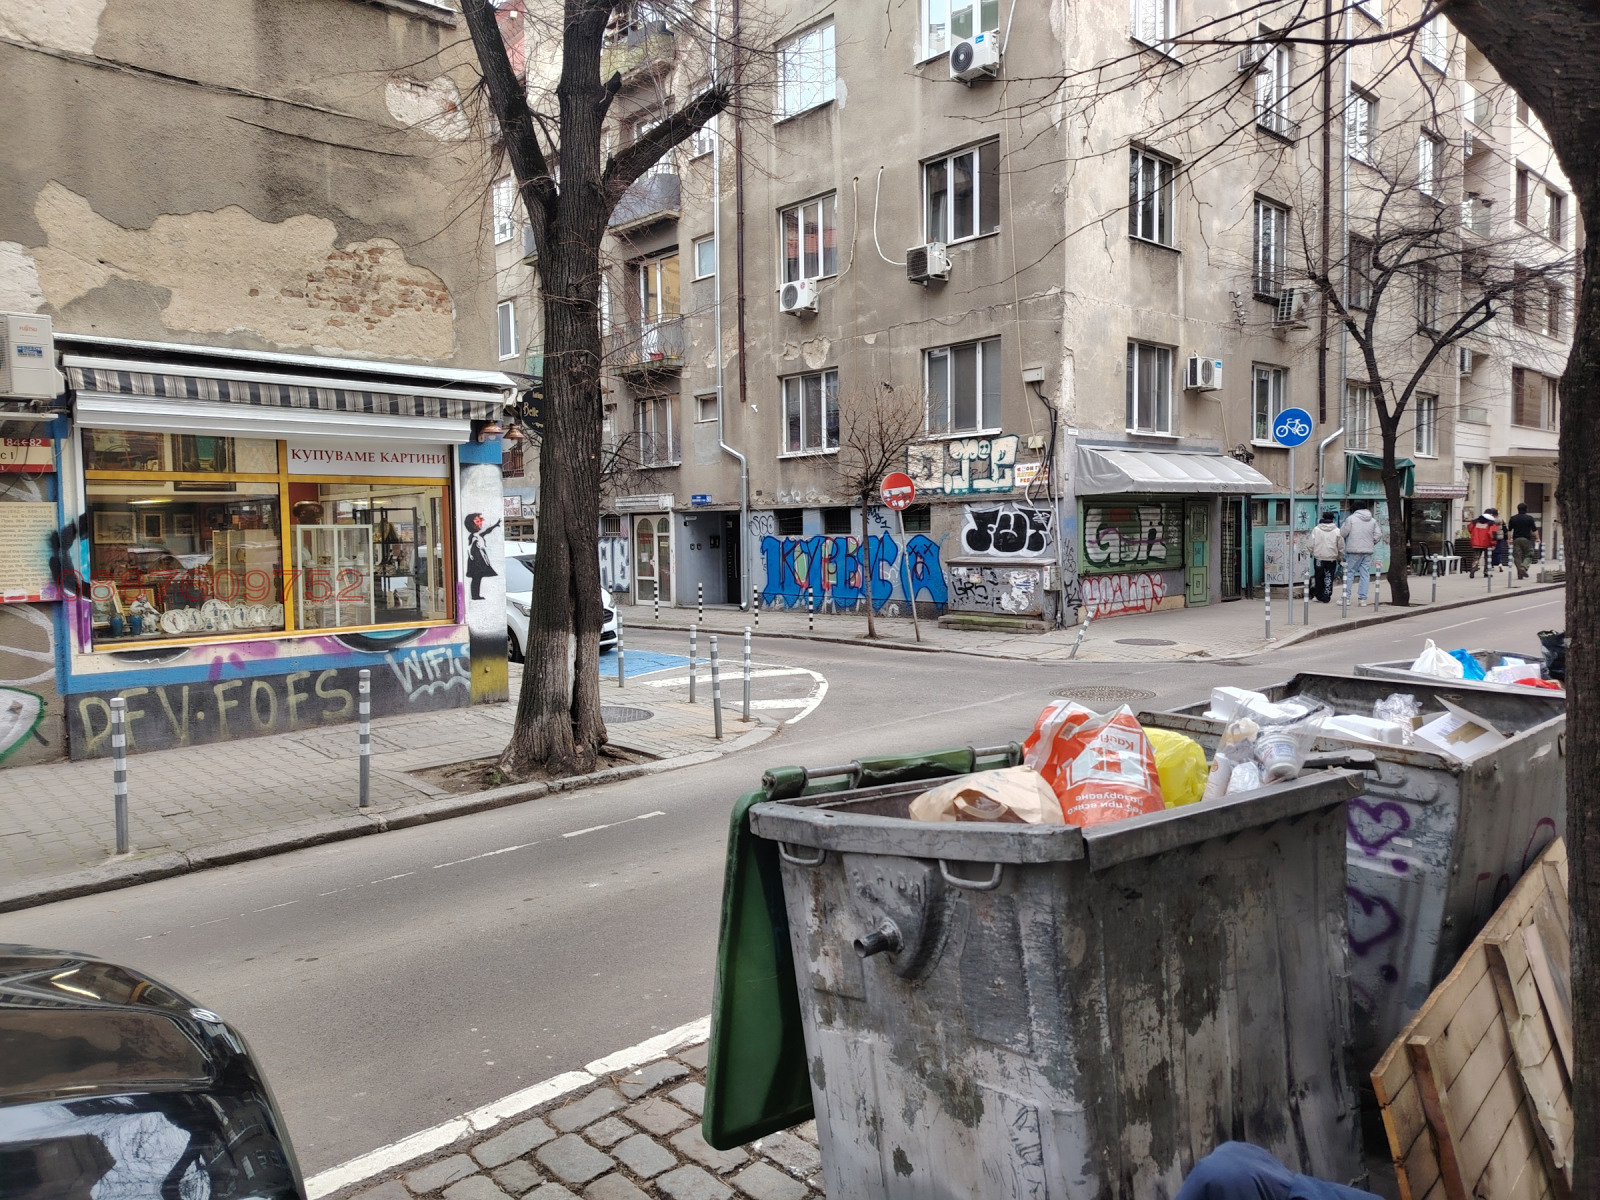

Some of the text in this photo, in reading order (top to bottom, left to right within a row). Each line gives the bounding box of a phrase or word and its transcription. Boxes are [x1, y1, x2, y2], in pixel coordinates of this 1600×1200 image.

[29, 438, 42, 447] 82
[291, 448, 447, 465] КУПУВАМЕ КАРТИНИ
